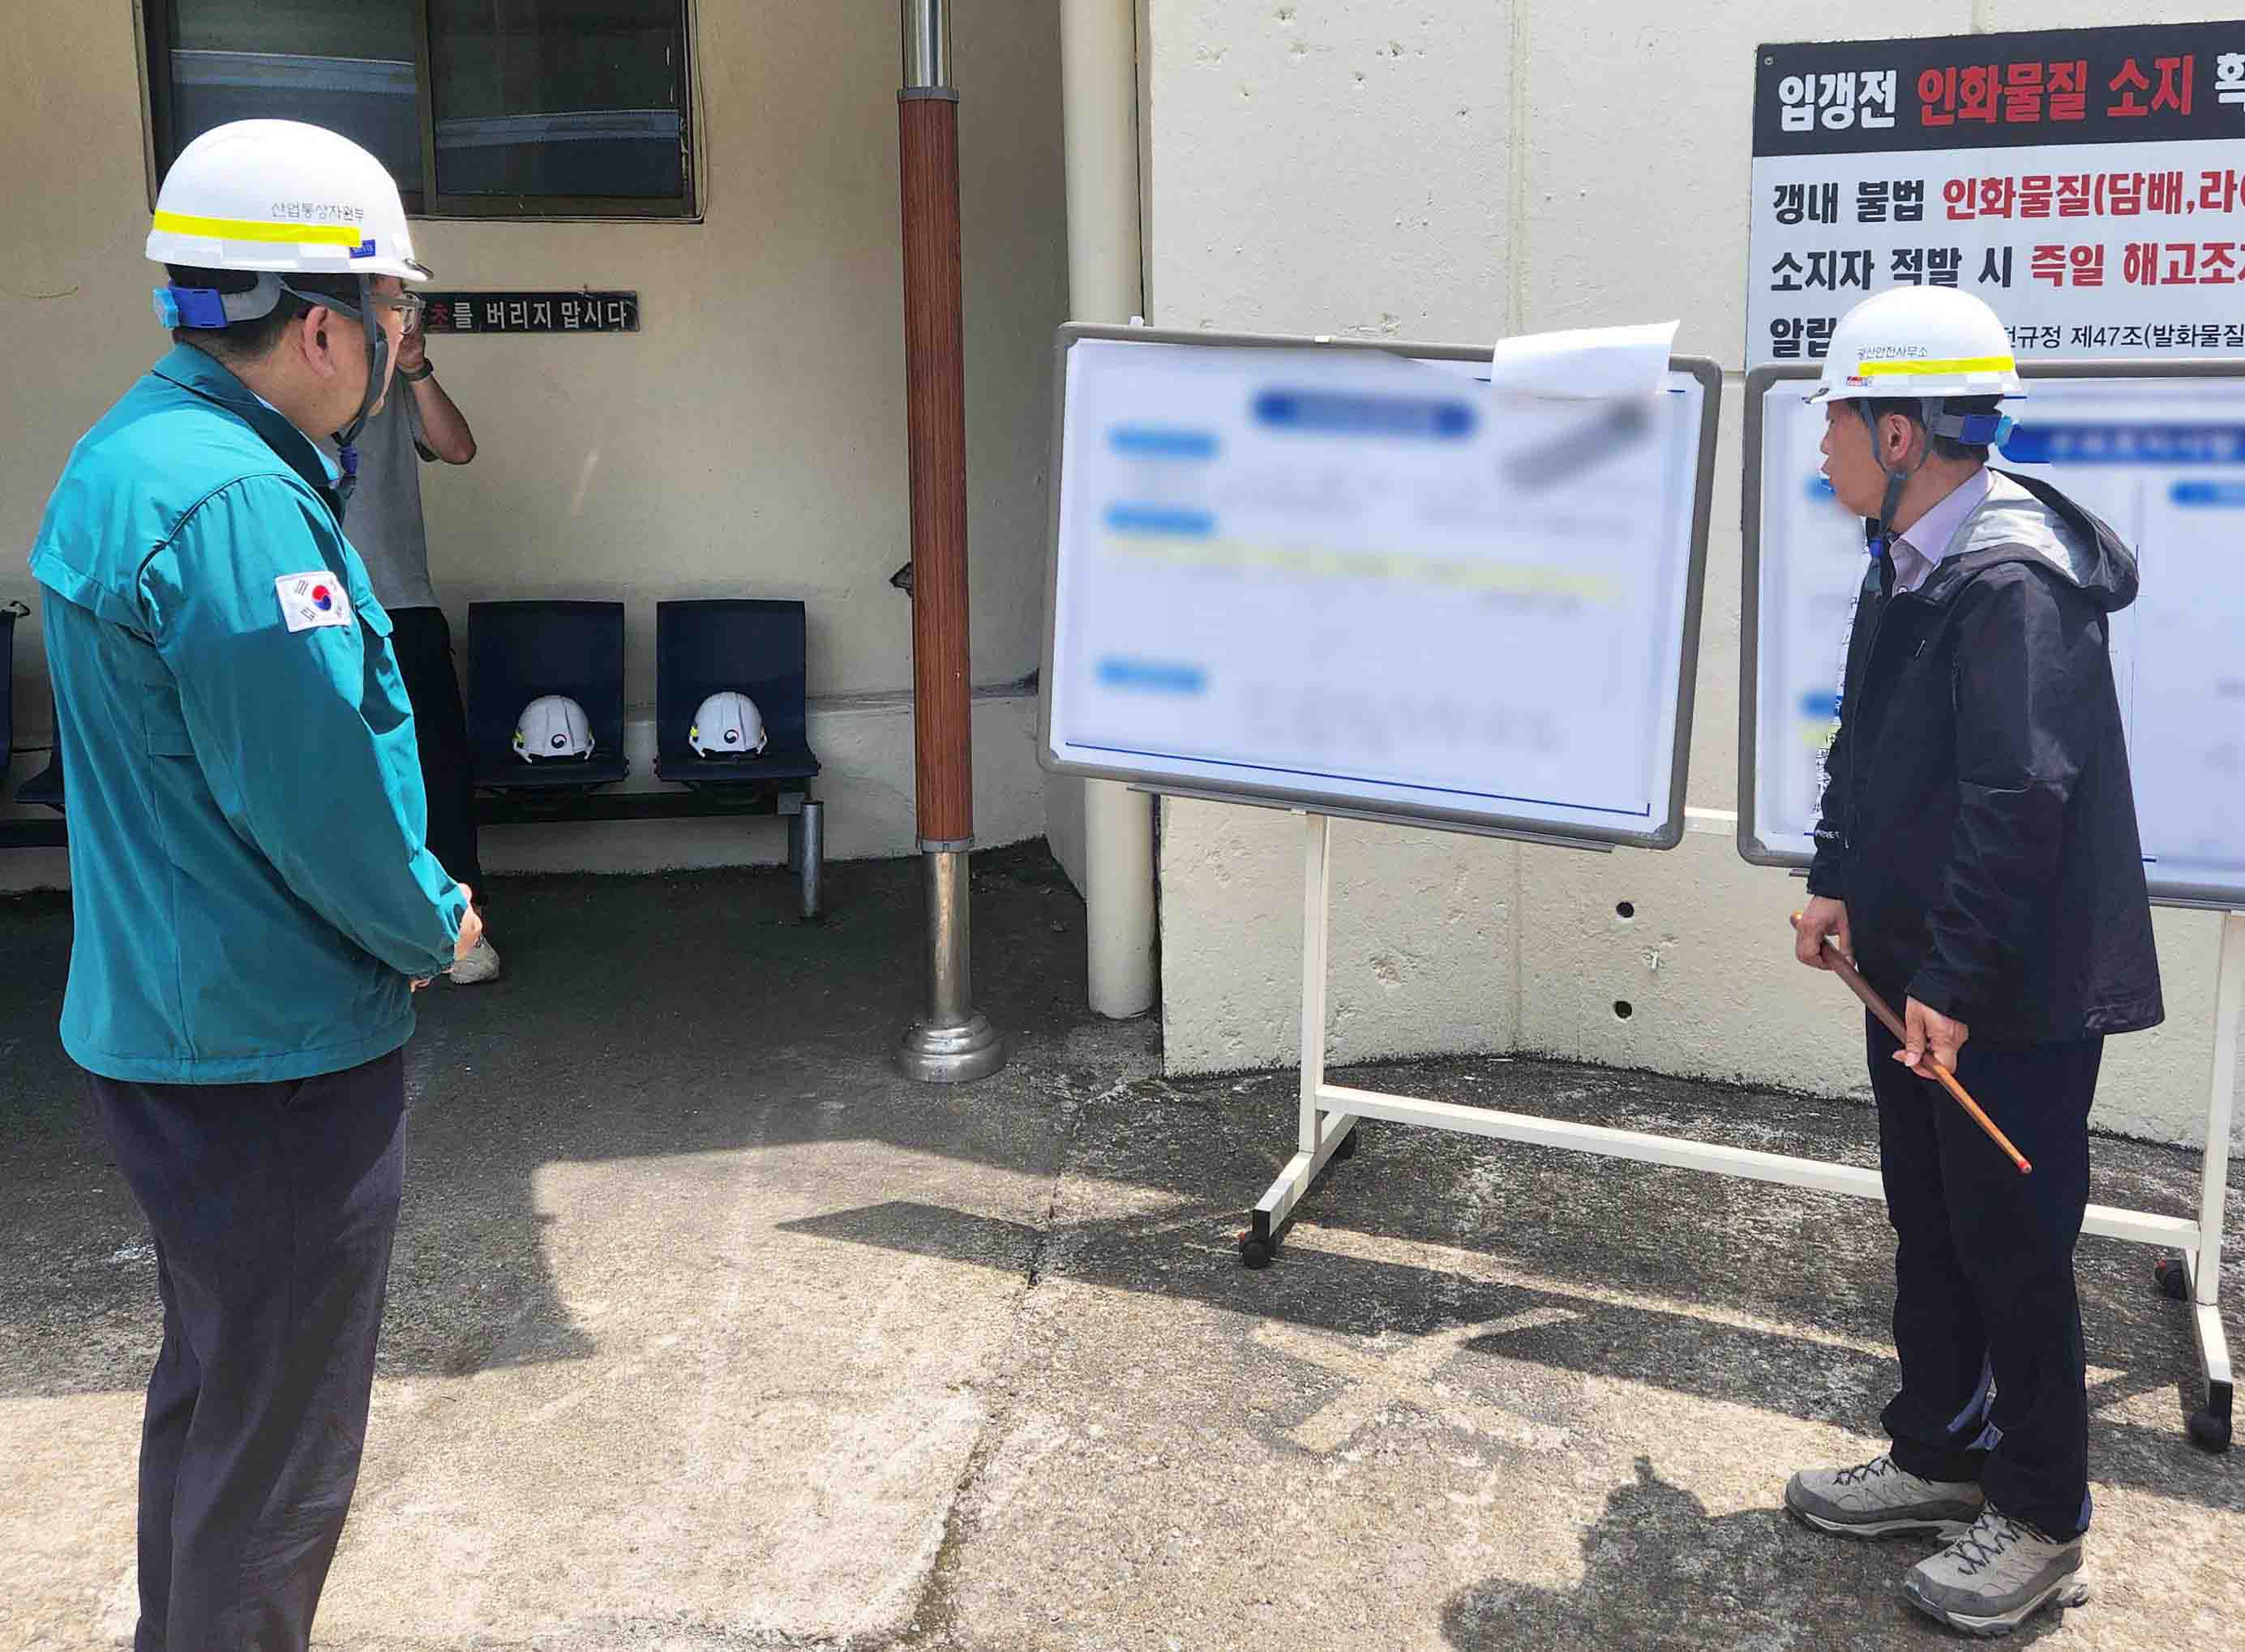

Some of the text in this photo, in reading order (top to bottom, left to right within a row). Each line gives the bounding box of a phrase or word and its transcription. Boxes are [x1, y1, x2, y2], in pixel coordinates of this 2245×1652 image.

[1777, 69, 1898, 132] 입갱전
[1917, 59, 2089, 127] 인화물질
[2106, 53, 2196, 118] 소지
[272, 202, 364, 221] 산업통상자원부
[1773, 169, 2245, 225] 갱내 불법 인화물질(담배,라
[1771, 242, 2245, 292] 소지자 적발 시 즉일 해고조
[431, 300, 628, 330] 초를 버리지 맙시다
